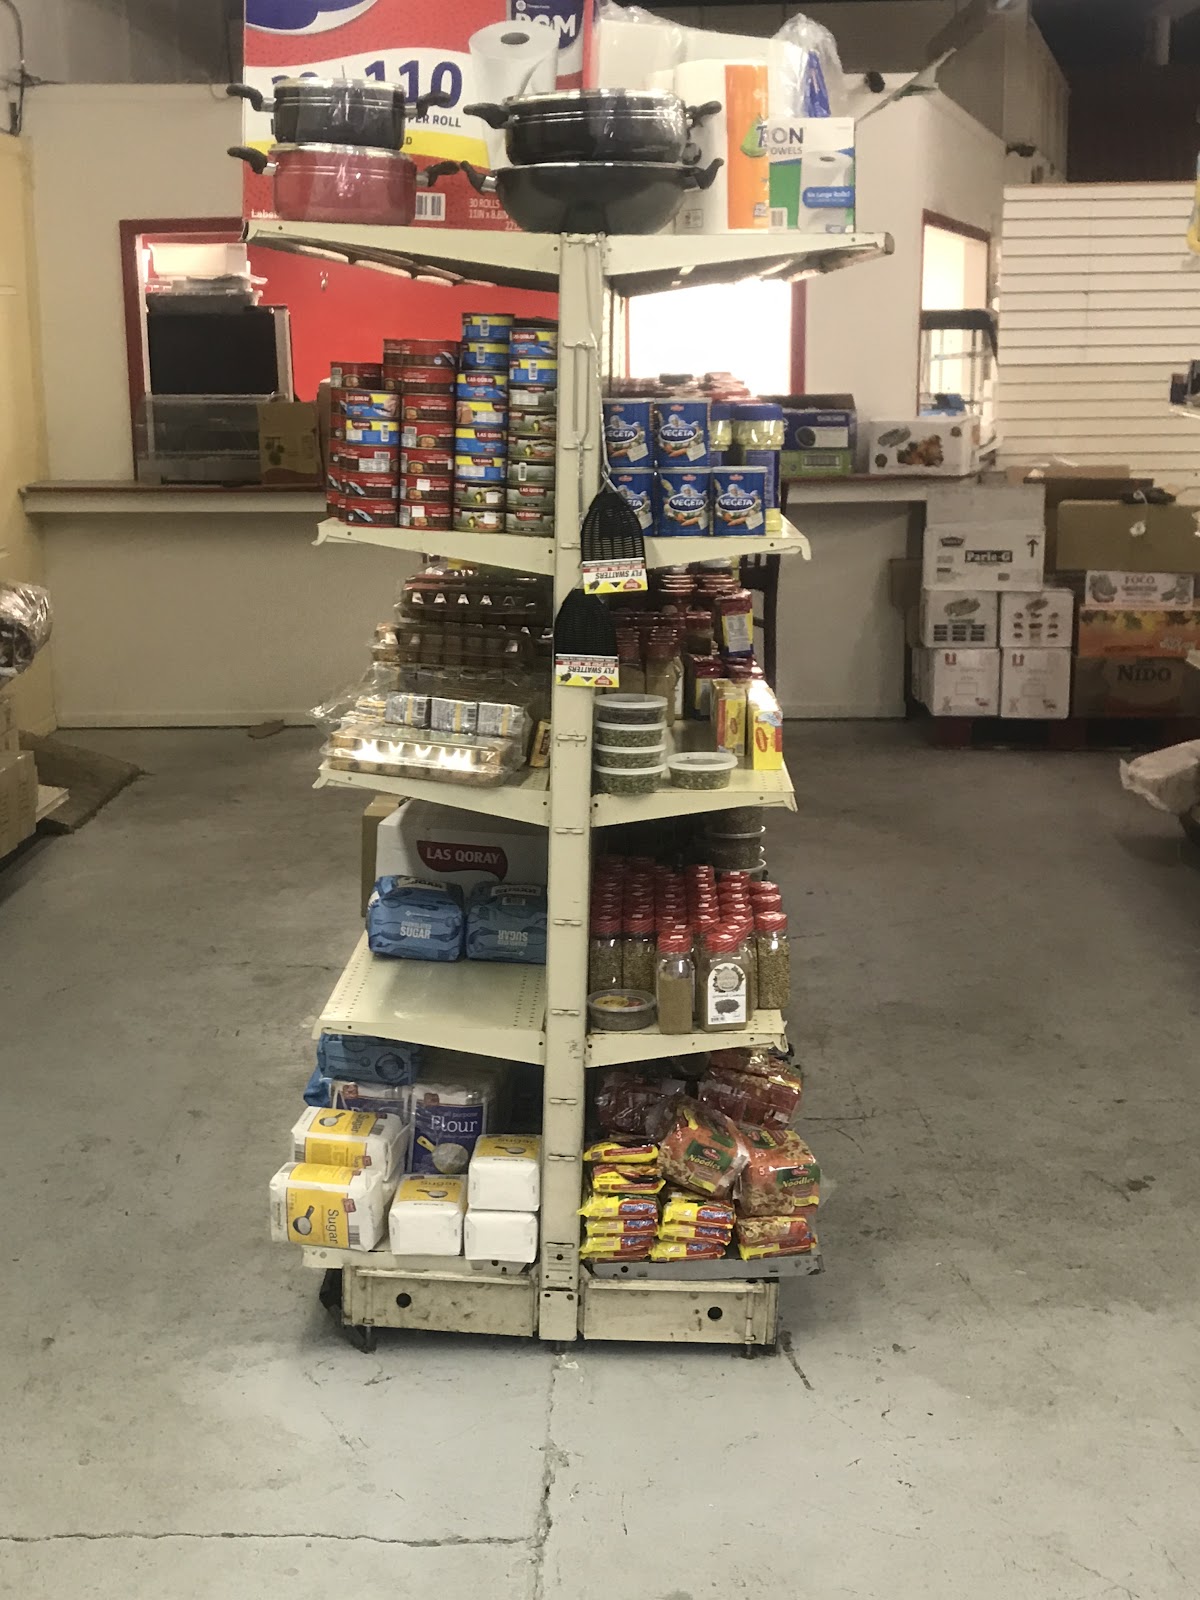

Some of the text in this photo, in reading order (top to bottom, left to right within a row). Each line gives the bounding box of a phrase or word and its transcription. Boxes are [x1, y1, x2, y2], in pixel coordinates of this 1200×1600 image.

[432, 114, 462, 128] ROLL
[469, 197, 500, 209] 30 ROLLS
[660, 428, 695, 437] VEGETA
[671, 498, 705, 507] VEGETA
[719, 498, 754, 507] VEGETA
[966, 552, 1011, 561] Parle-G
[595, 569, 643, 580] FLY SWATTERS
[567, 665, 615, 675] FLY SWATTERS
[426, 847, 502, 865] LAS QORAY
[399, 926, 432, 940] SUGAR
[497, 929, 529, 943] SUGAR
[351, 1113, 370, 1134] Sugar
[430, 1114, 479, 1133] Flour
[687, 1153, 722, 1171] Noodles
[781, 1175, 816, 1189] Noodles
[325, 1208, 340, 1245] Sugar
